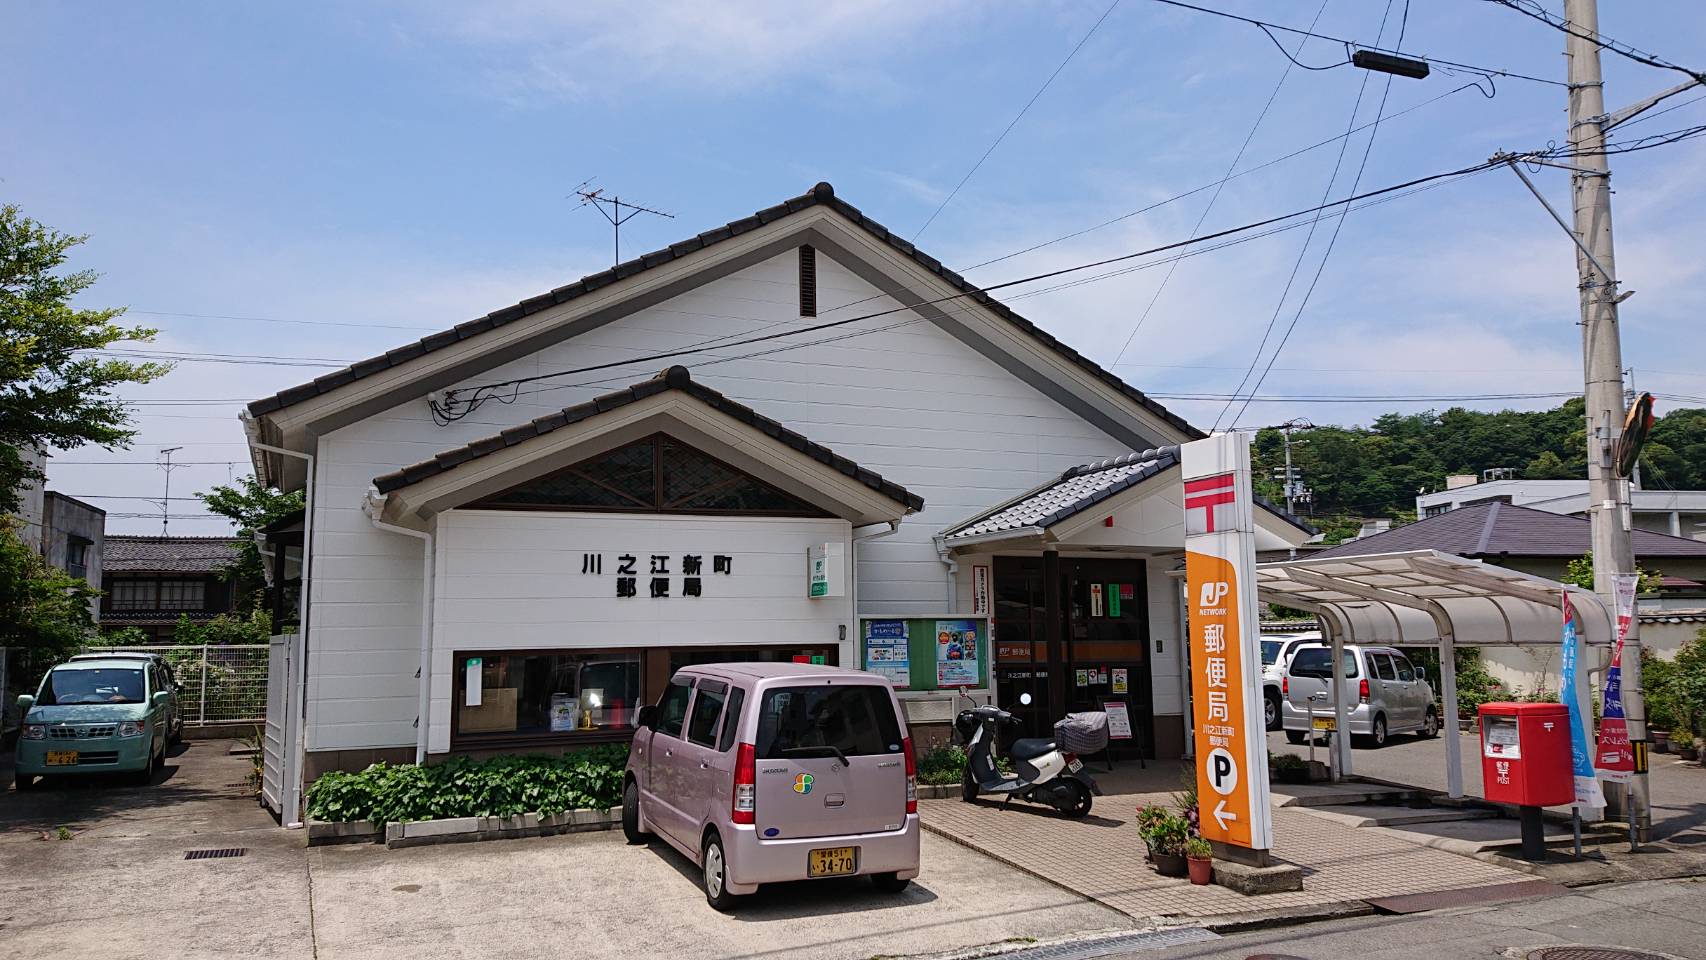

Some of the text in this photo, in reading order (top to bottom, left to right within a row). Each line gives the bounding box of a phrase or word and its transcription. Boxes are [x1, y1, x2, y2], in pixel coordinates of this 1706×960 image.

[582, 553, 733, 575] 川之江新町
[616, 577, 702, 598] 郵便局
[1200, 581, 1229, 606] JP
[1199, 608, 1227, 616] NETWORK
[1204, 624, 1228, 722] 郵便局
[1202, 723, 1235, 737] 川之江新町
[1213, 754, 1231, 788] P
[1497, 776, 1510, 785] POST
[820, 858, 852, 873] 34-70
